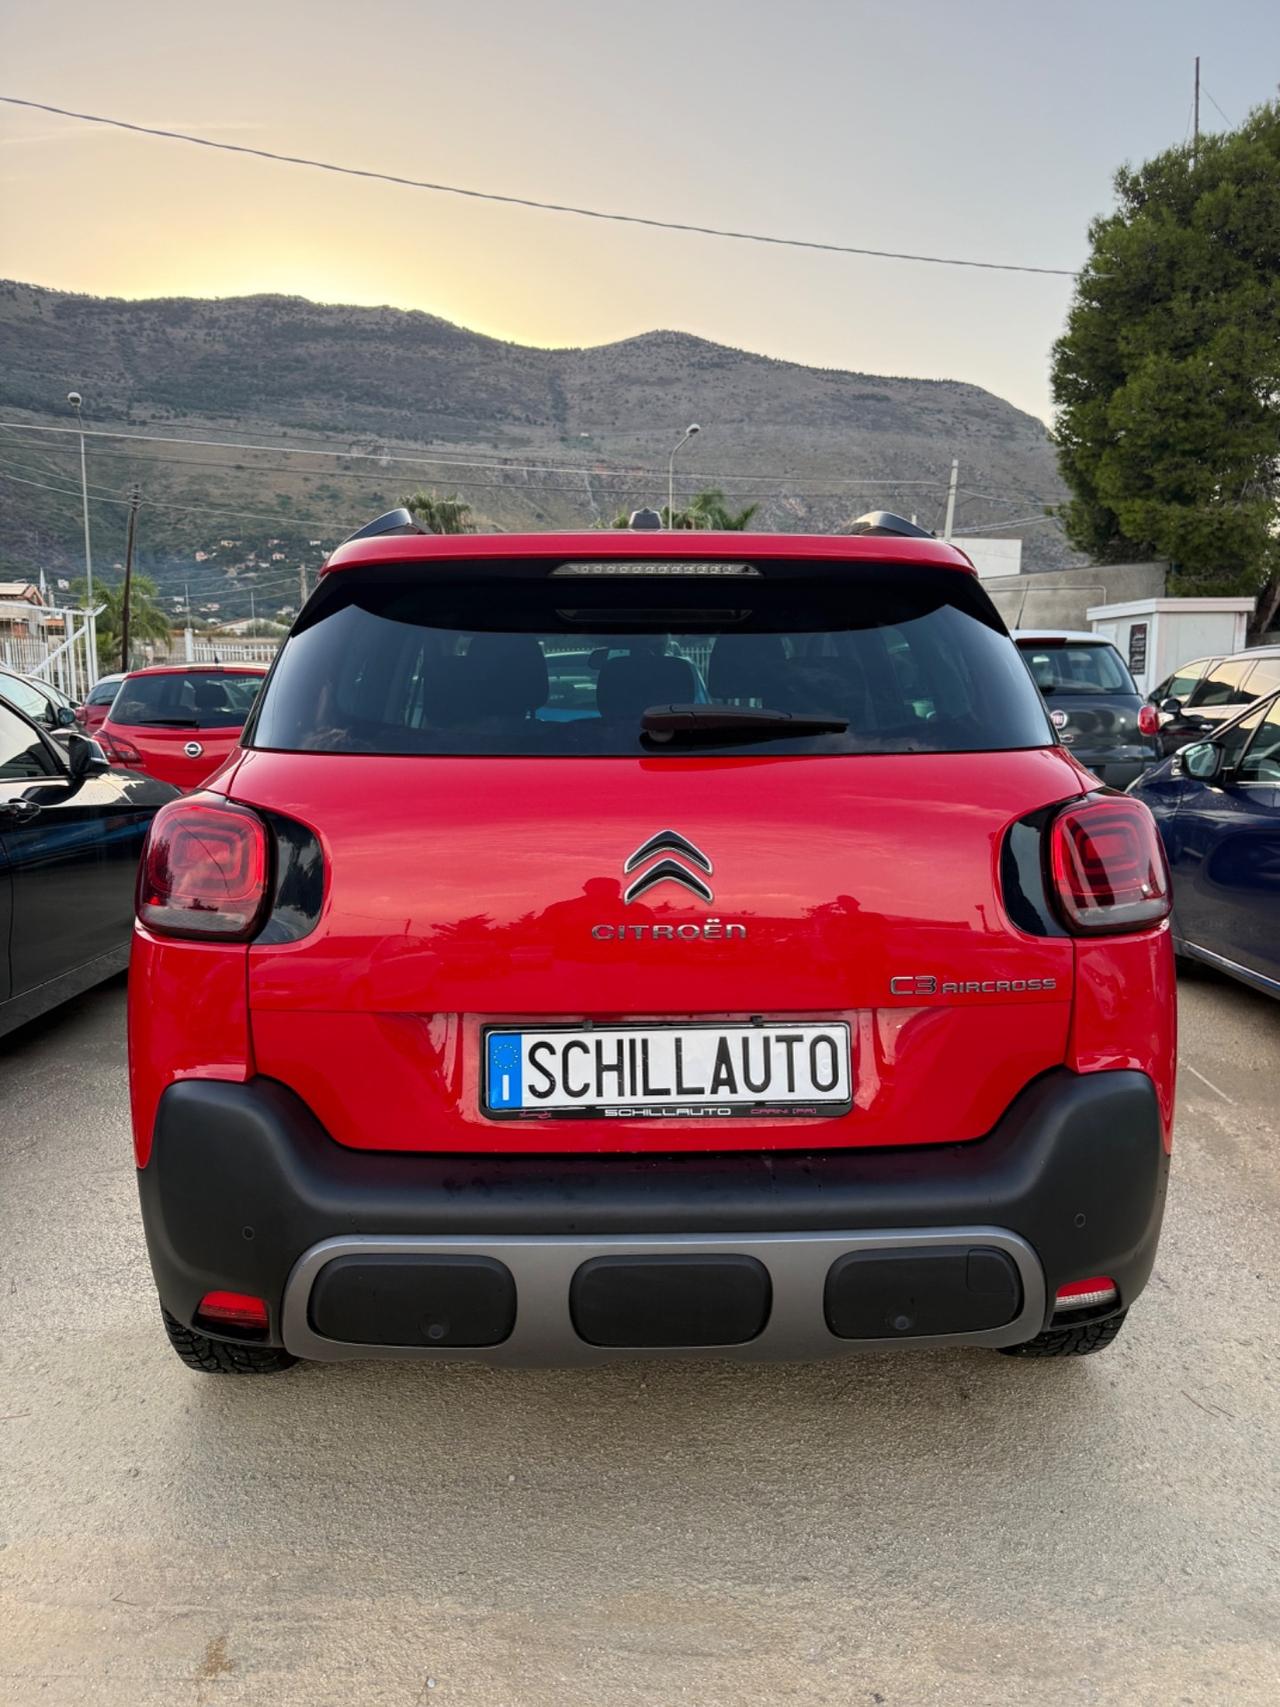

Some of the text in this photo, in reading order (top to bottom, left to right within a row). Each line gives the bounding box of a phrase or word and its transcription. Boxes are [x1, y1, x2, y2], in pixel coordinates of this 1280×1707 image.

[591, 919, 746, 940] CITROËN
[890, 975, 1056, 996] C3 AIRCROSS
[528, 1034, 839, 1099] SCHILLAUTO
[604, 1108, 732, 1117] SCHILLAUTO
